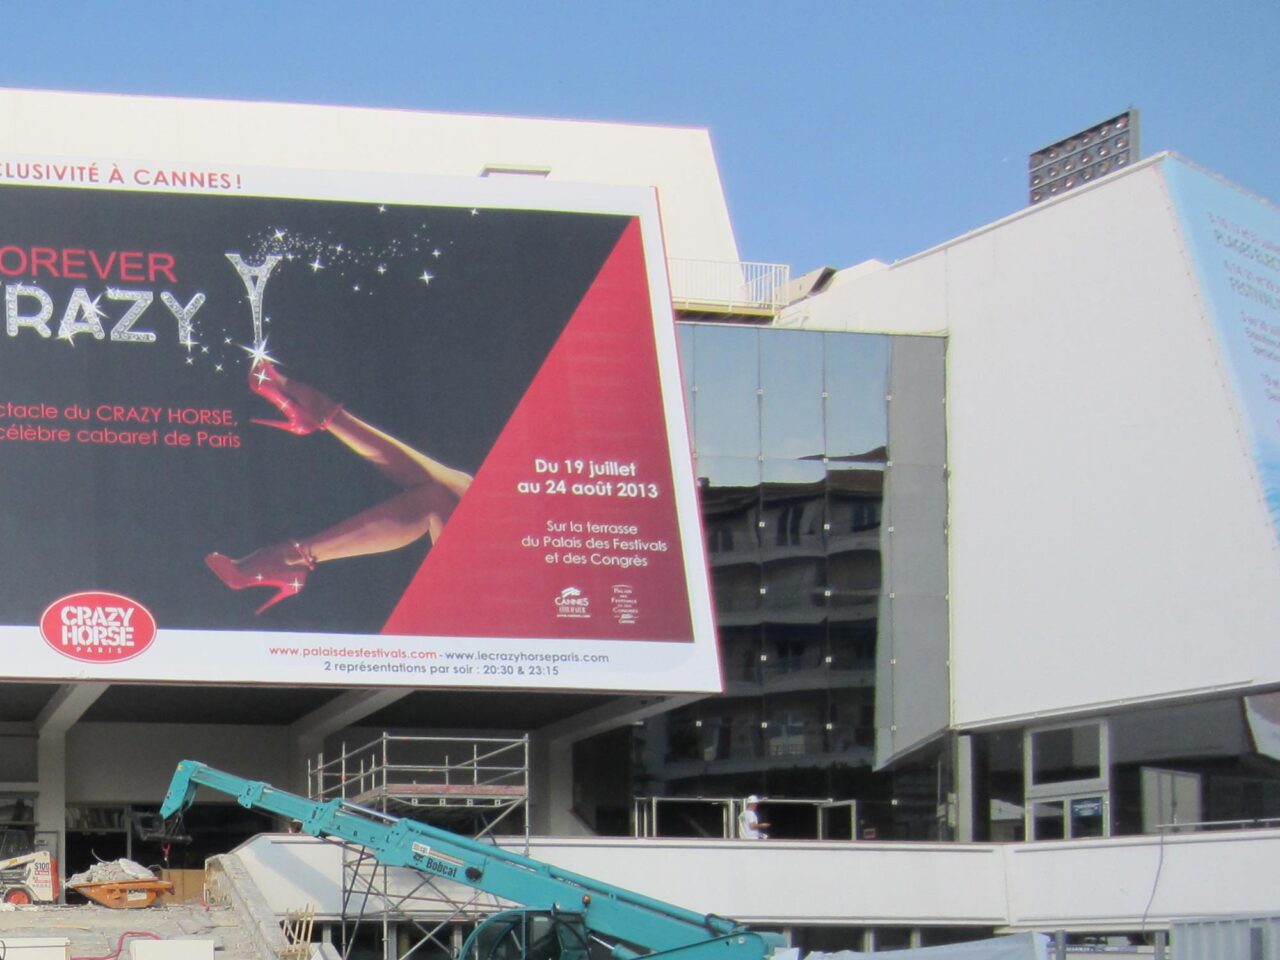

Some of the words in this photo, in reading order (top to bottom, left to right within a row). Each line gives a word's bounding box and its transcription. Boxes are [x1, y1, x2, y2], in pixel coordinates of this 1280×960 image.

[109, 163, 124, 184] À
[64, 403, 90, 421] du
[96, 405, 162, 423] CRAZY
[77, 427, 158, 445] cabaret
[164, 430, 191, 447] de
[197, 431, 241, 448] Paris
[535, 459, 558, 473] Du
[565, 460, 583, 474] 19
[589, 460, 636, 478] juillet
[518, 481, 540, 493] au
[545, 480, 566, 494] 24
[571, 480, 612, 497] août
[617, 483, 659, 498] 2013
[546, 520, 566, 532] Sur
[570, 520, 583, 532] la
[587, 521, 638, 535] terrasse
[521, 536, 540, 547] du
[543, 536, 582, 549] Palais
[585, 538, 610, 550] des
[613, 538, 668, 552] Festivals
[545, 552, 559, 563] et
[562, 552, 587, 564] des
[590, 553, 648, 569] Congrès
[61, 606, 135, 627] CRAZY
[62, 626, 135, 647] HORSE
[269, 645, 437, 660] www.palaisdesfestivals.com
[445, 649, 609, 665] www.lecrazyhorseparis.com
[324, 661, 331, 671] 2
[334, 660, 426, 675] représentations
[430, 664, 450, 676] par
[453, 663, 473, 674] soir
[483, 664, 514, 675] 20:30
[528, 665, 559, 676] 23:15
[426, 859, 457, 878] Bobcat
